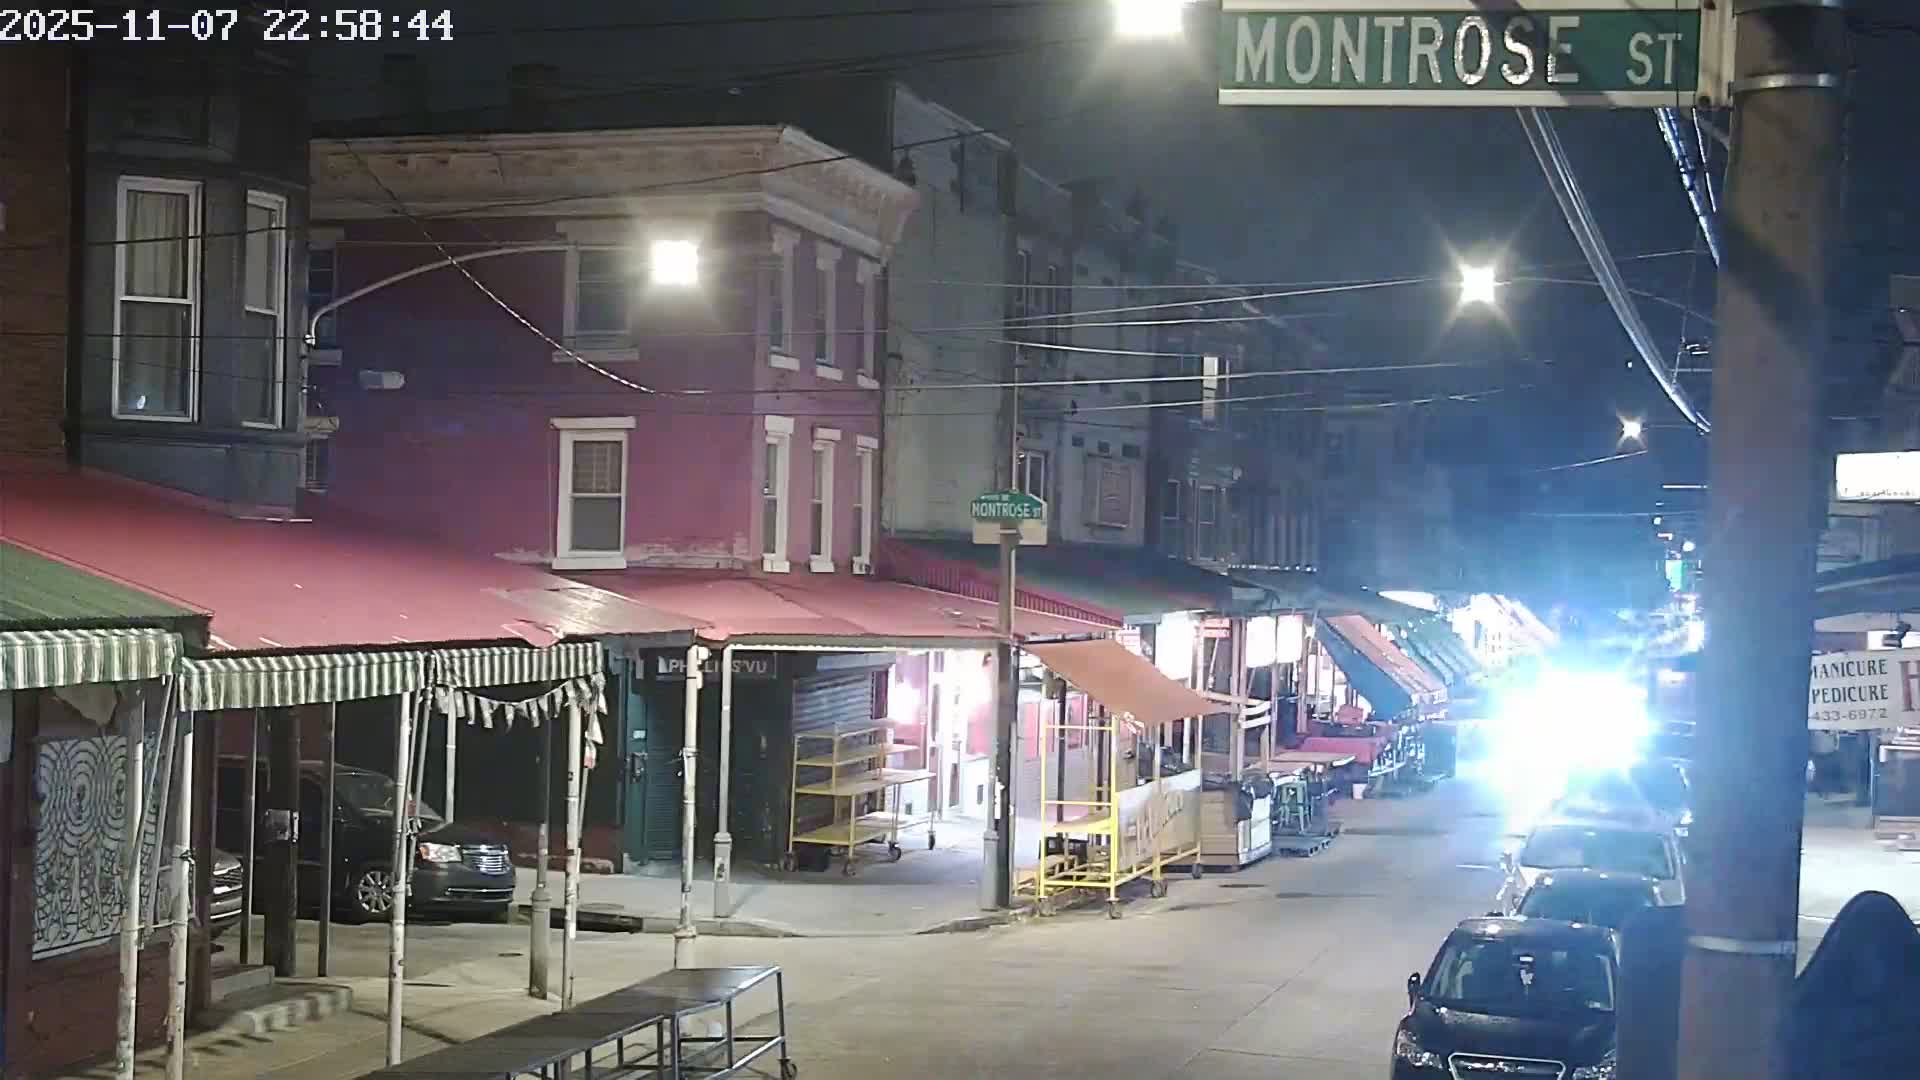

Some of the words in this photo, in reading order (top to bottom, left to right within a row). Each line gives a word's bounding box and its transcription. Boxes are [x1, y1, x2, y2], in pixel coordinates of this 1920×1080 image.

[1234, 15, 1580, 85] MONTROSE
[1626, 32, 1682, 85] ST
[972, 502, 1030, 517] MONTROSE
[1813, 659, 1888, 679] ANICURE
[1812, 684, 1889, 704] PEDICURE
